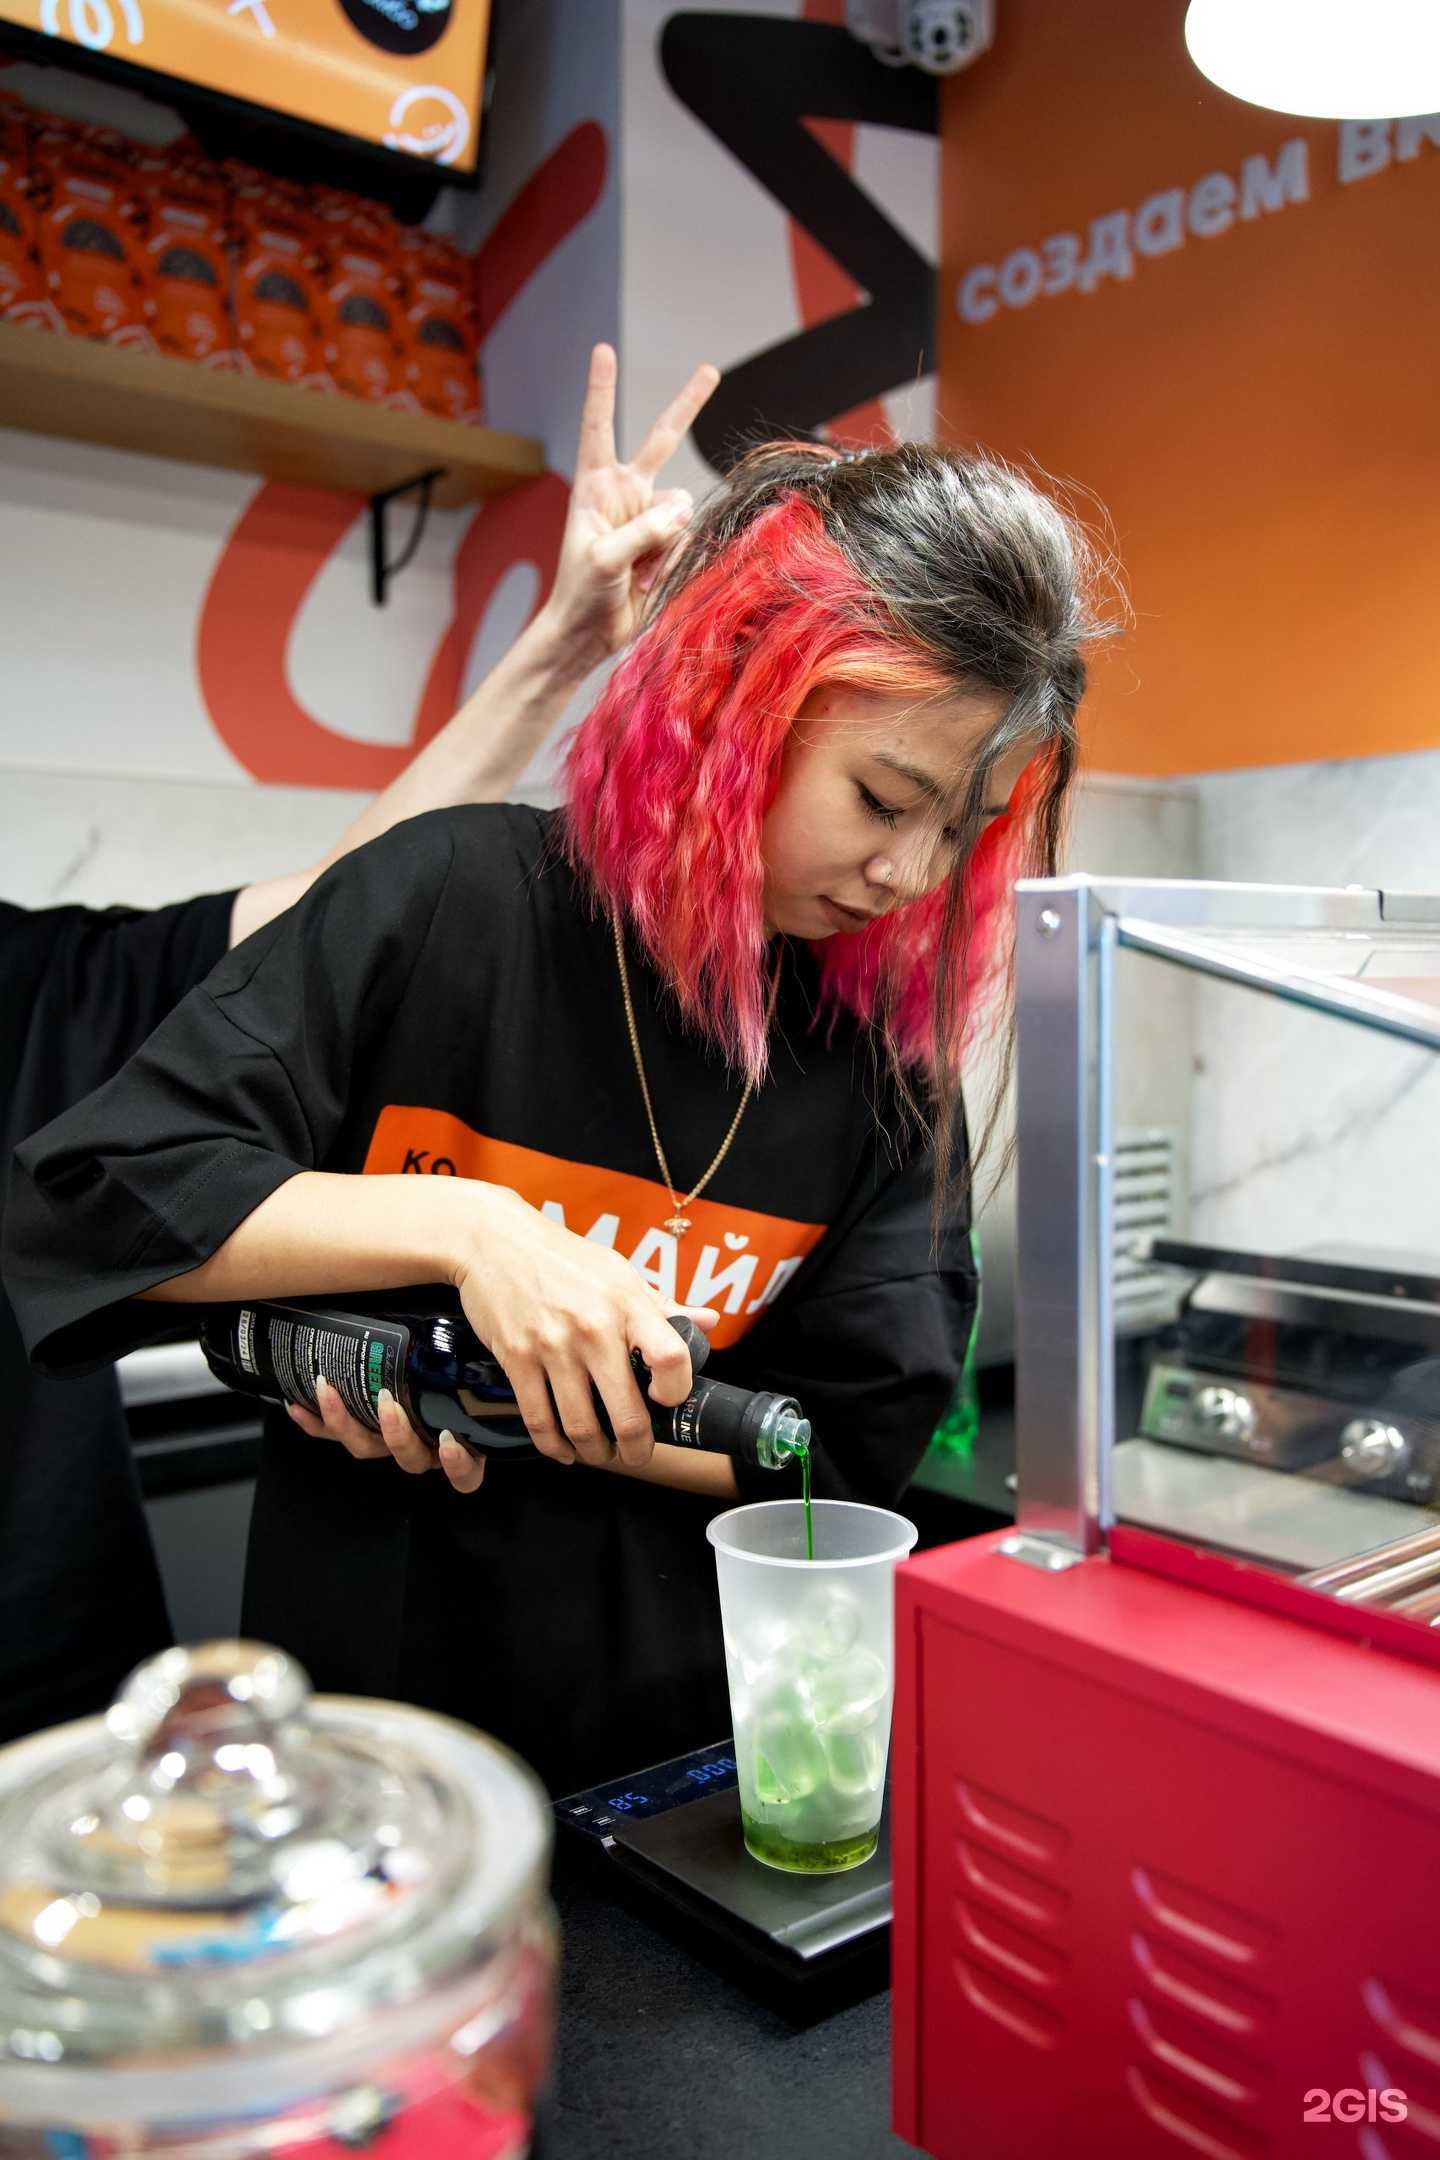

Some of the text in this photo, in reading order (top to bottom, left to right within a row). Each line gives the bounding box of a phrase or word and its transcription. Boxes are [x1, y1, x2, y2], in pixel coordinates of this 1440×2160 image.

[956, 139, 1309, 324] создаем
[368, 1341, 384, 1392] GREEN
[680, 1393, 698, 1443] ARLINE
